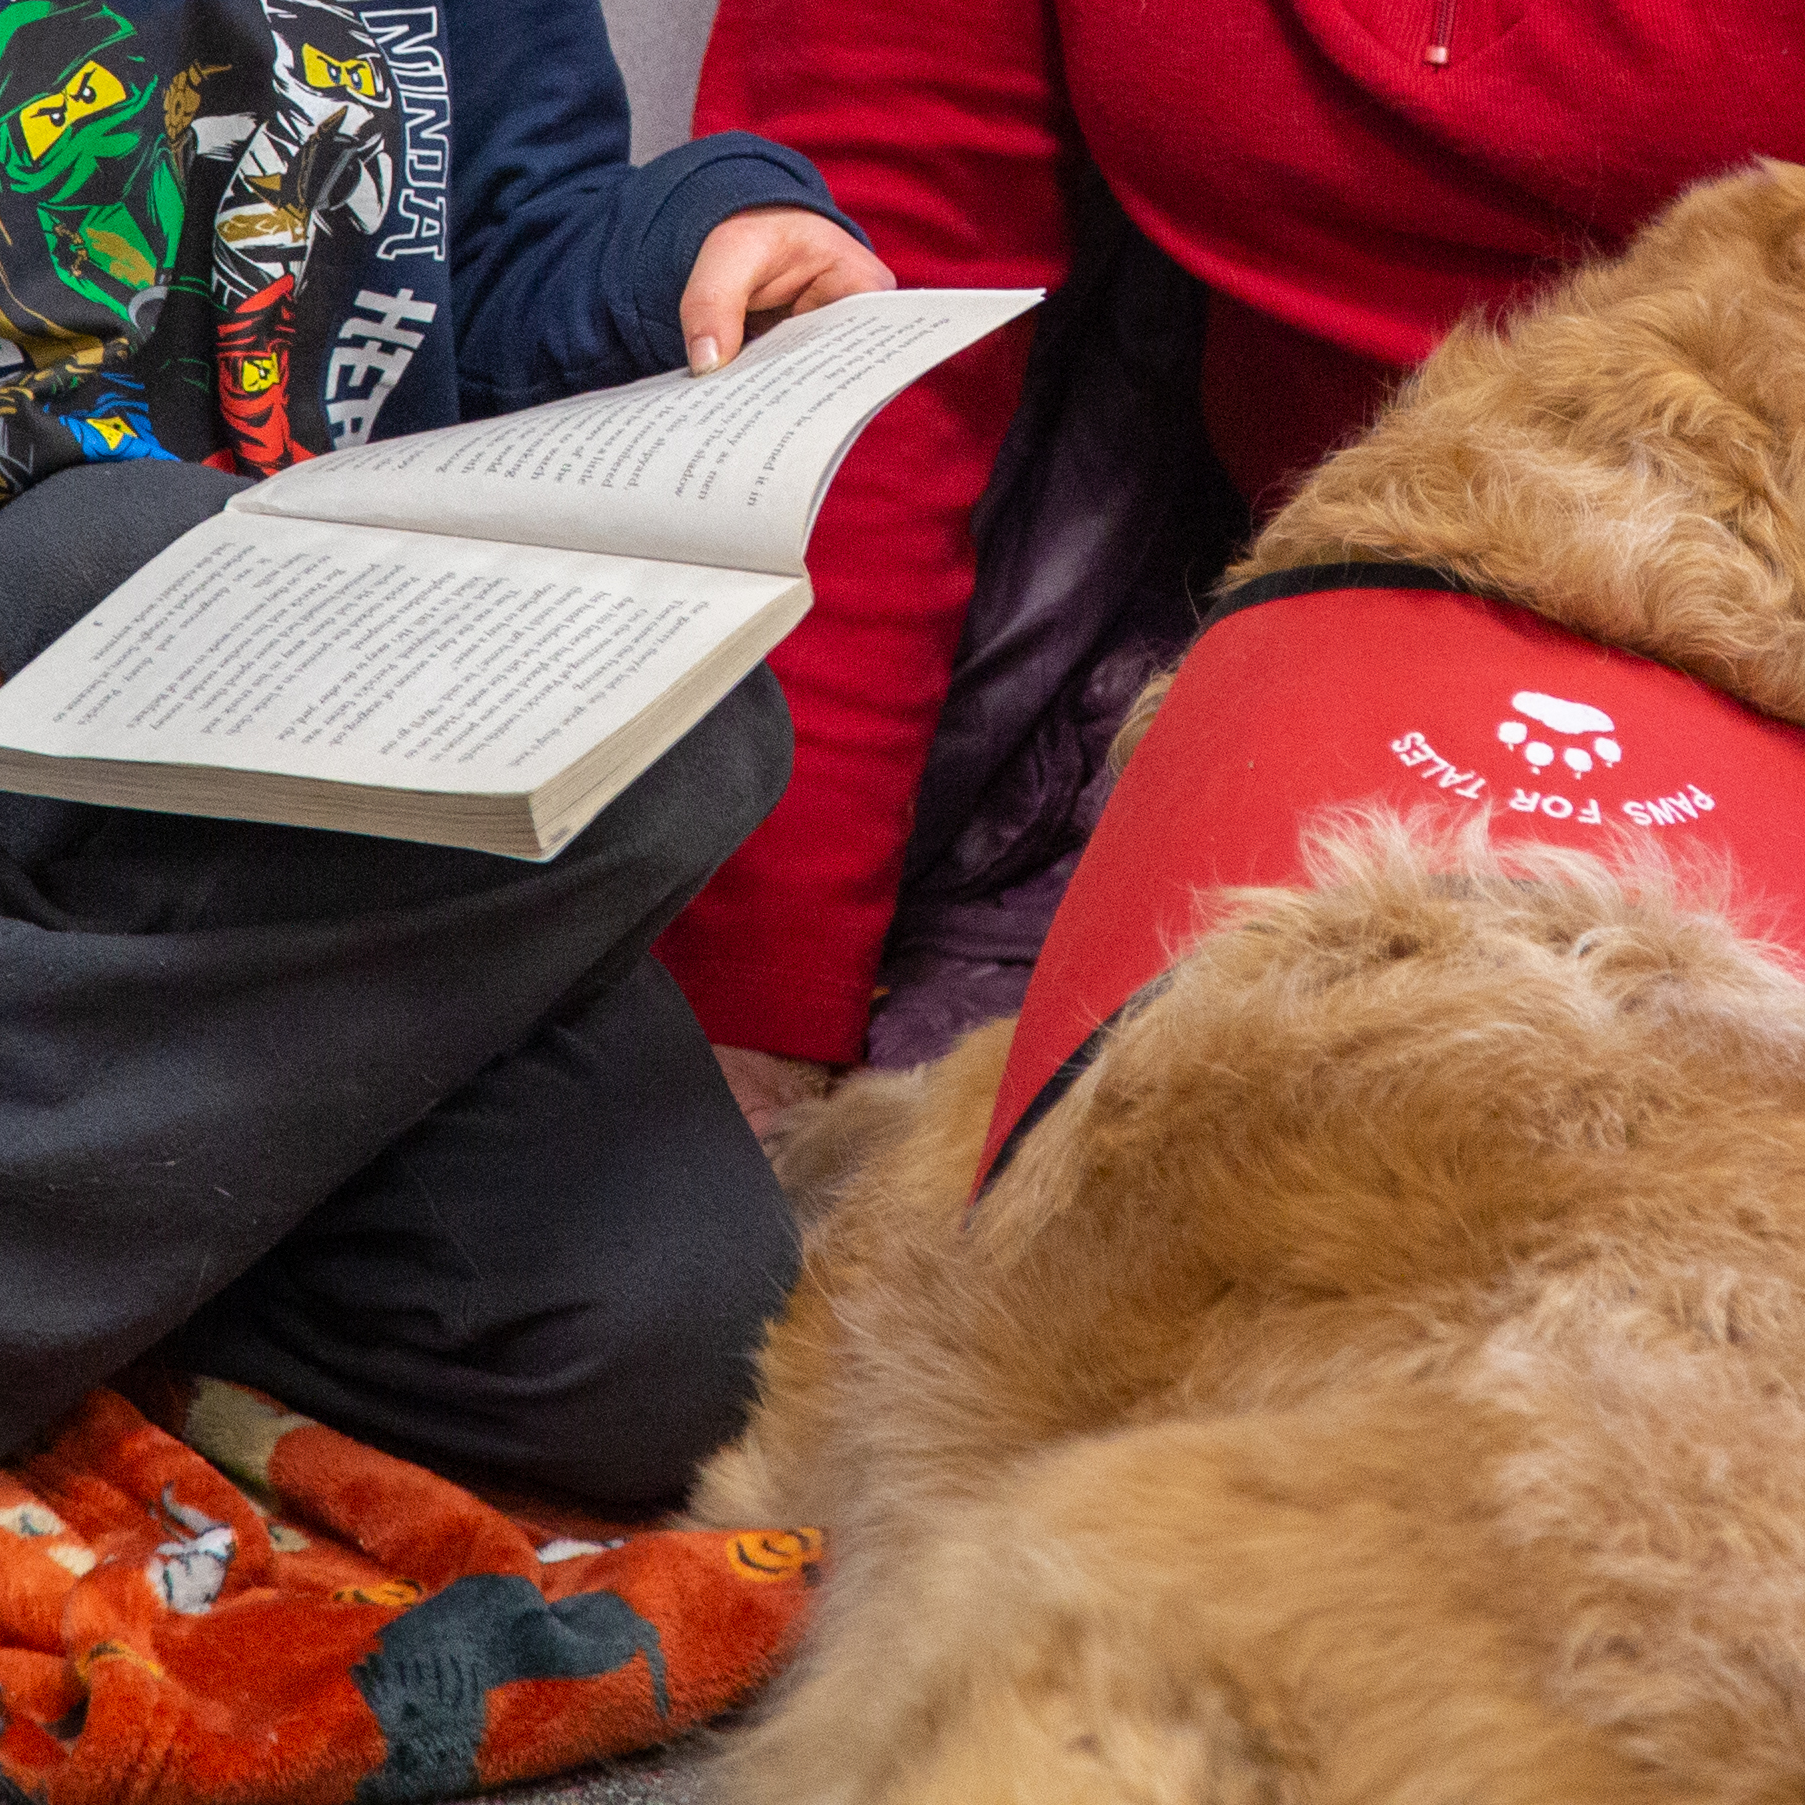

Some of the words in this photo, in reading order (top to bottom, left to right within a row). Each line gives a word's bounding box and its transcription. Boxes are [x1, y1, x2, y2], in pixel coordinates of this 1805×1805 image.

[716, 451, 729, 464] as
[763, 431, 795, 471] turned
[675, 449, 705, 497] shadow
[698, 471, 717, 500] men
[755, 476, 768, 485] it
[747, 491, 759, 506] in
[534, 623, 570, 647] before
[521, 648, 540, 658] he
[1390, 731, 1488, 801] TALES
[1509, 787, 1602, 826] FOR
[1621, 782, 1717, 828] PAWS
